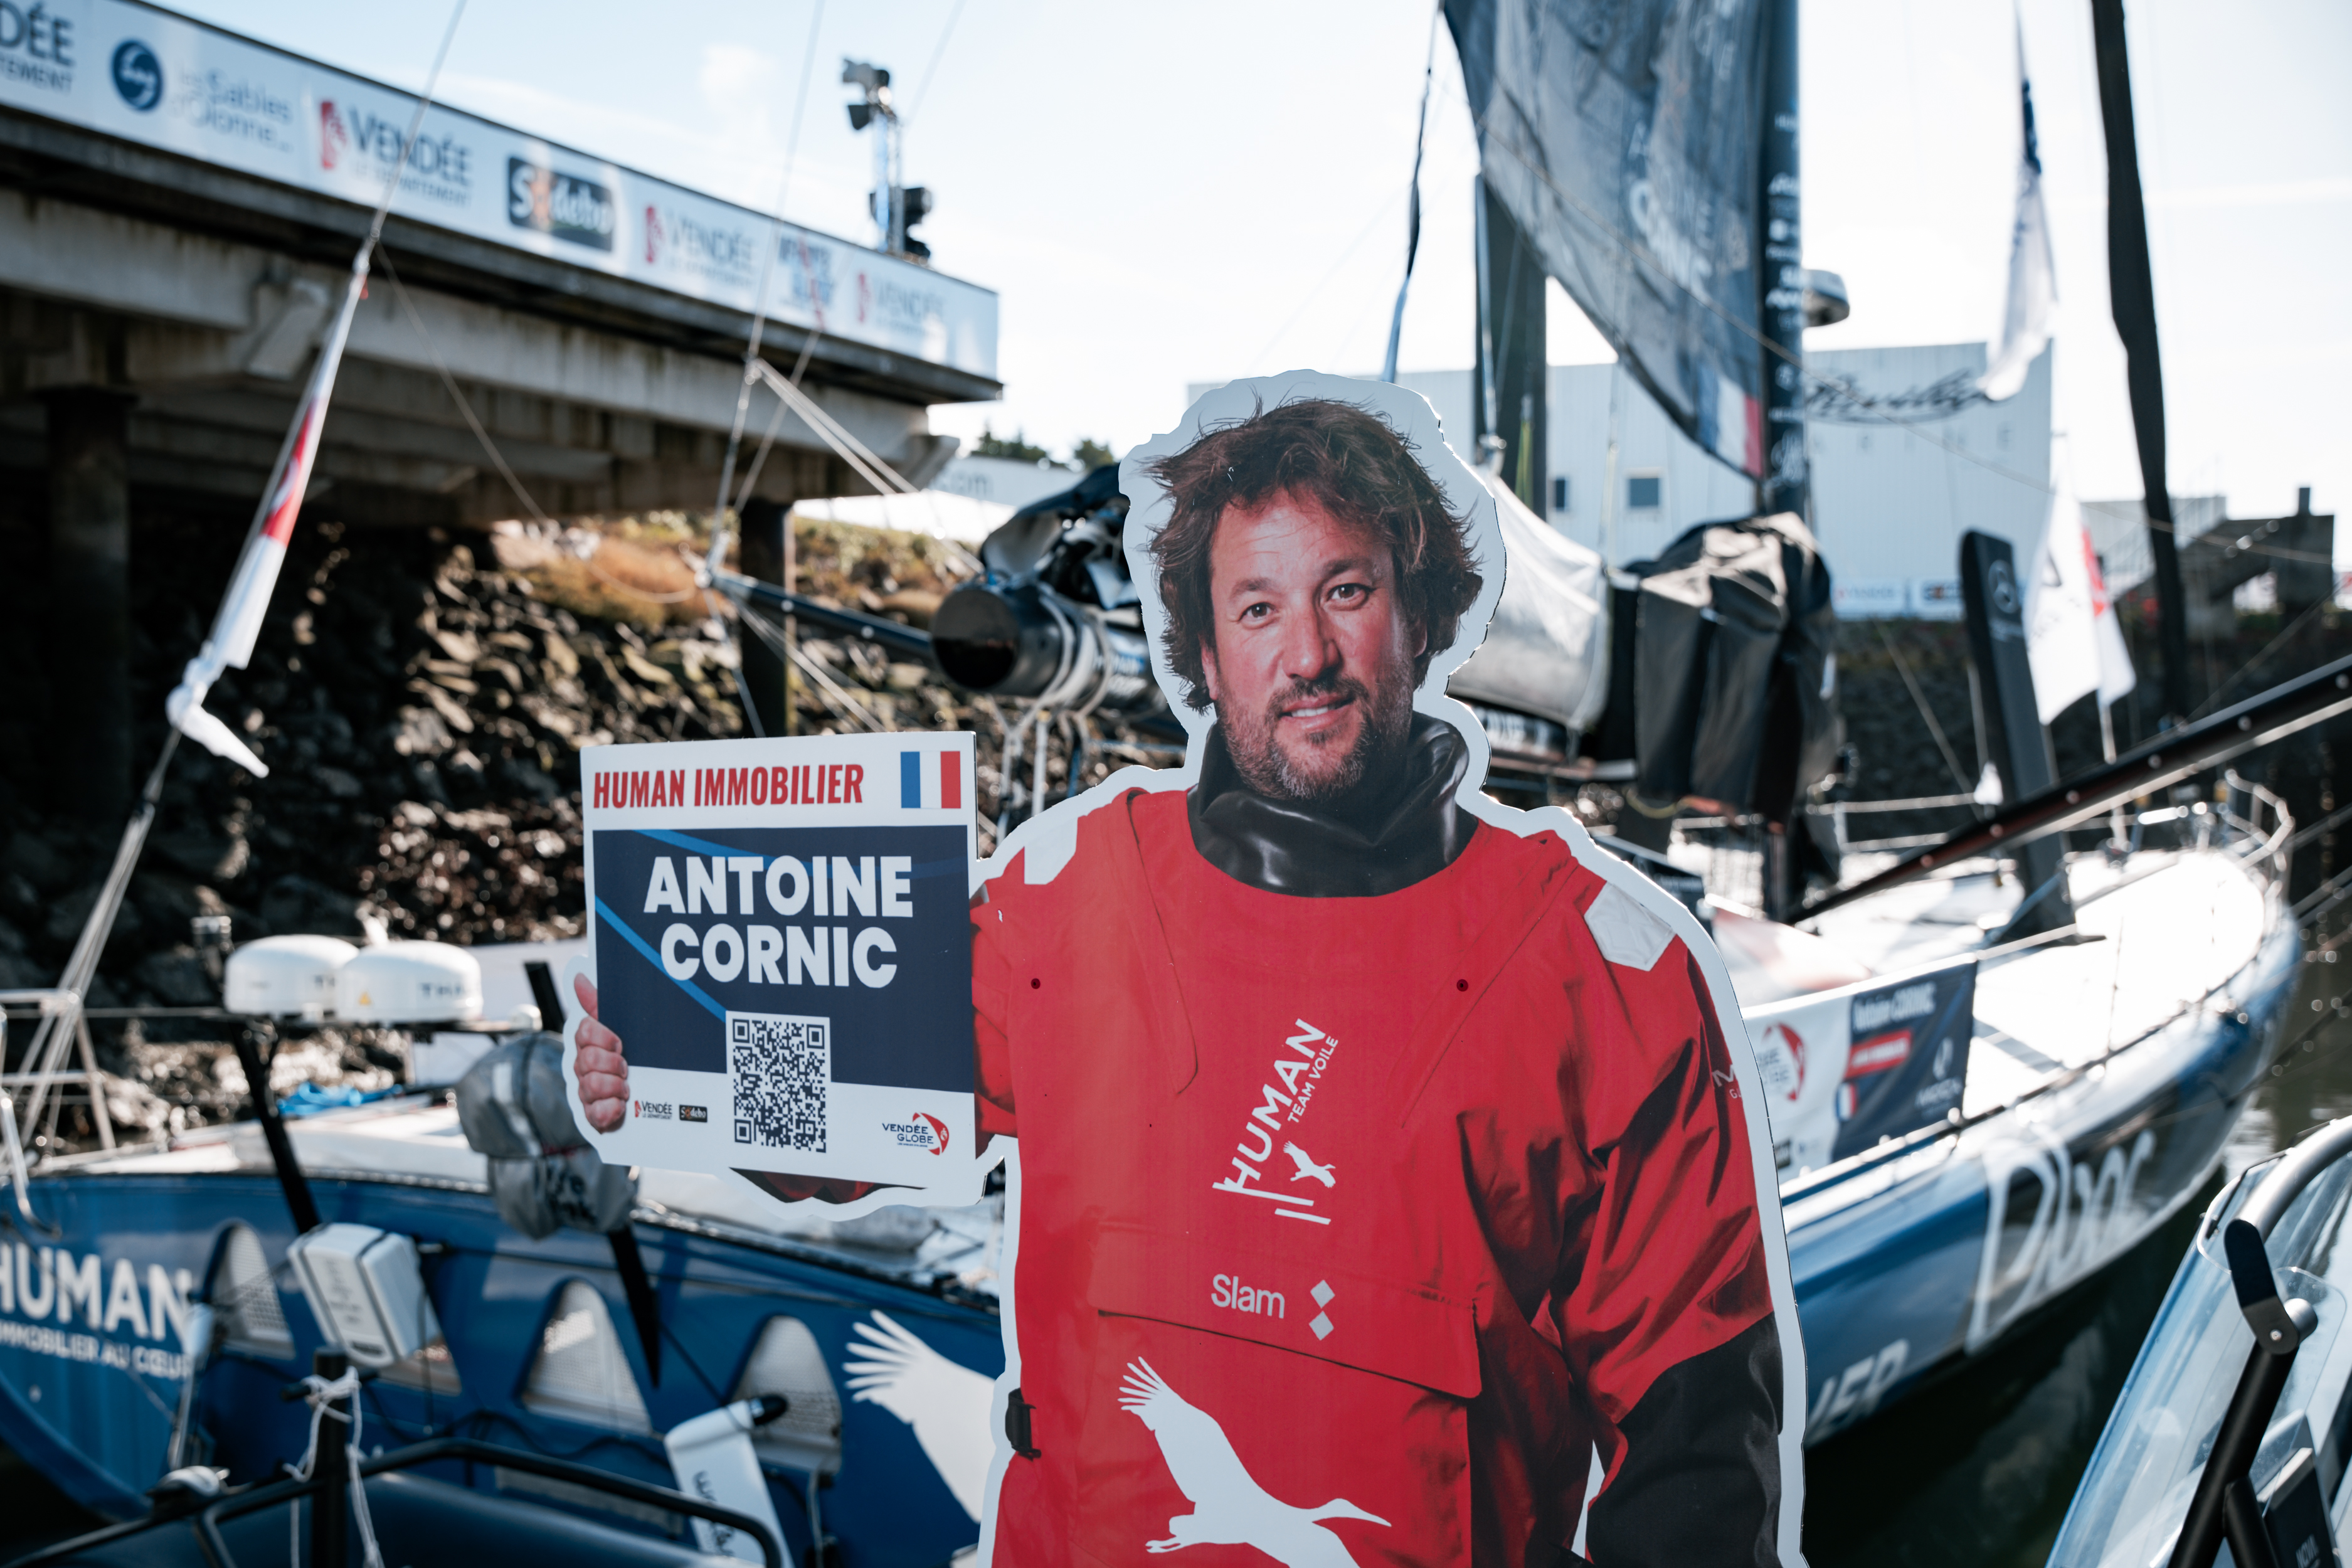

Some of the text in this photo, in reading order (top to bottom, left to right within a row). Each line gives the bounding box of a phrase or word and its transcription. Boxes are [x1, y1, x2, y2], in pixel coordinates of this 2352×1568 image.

[347, 103, 472, 187] VENDÉE
[593, 764, 864, 808] HUMAN IMMOBILIER
[644, 855, 914, 918] ANTOINE
[660, 923, 898, 988] CORNIC
[1287, 1036, 1339, 1123] TEAM VOILE
[641, 1100, 672, 1115] VENDÉE
[681, 1106, 706, 1118] Sodebo
[1223, 1018, 1327, 1191] HUMAN
[882, 1123, 928, 1135] VENDÉE
[897, 1133, 934, 1144] GLOBE
[1211, 1274, 1285, 1319] Slam
